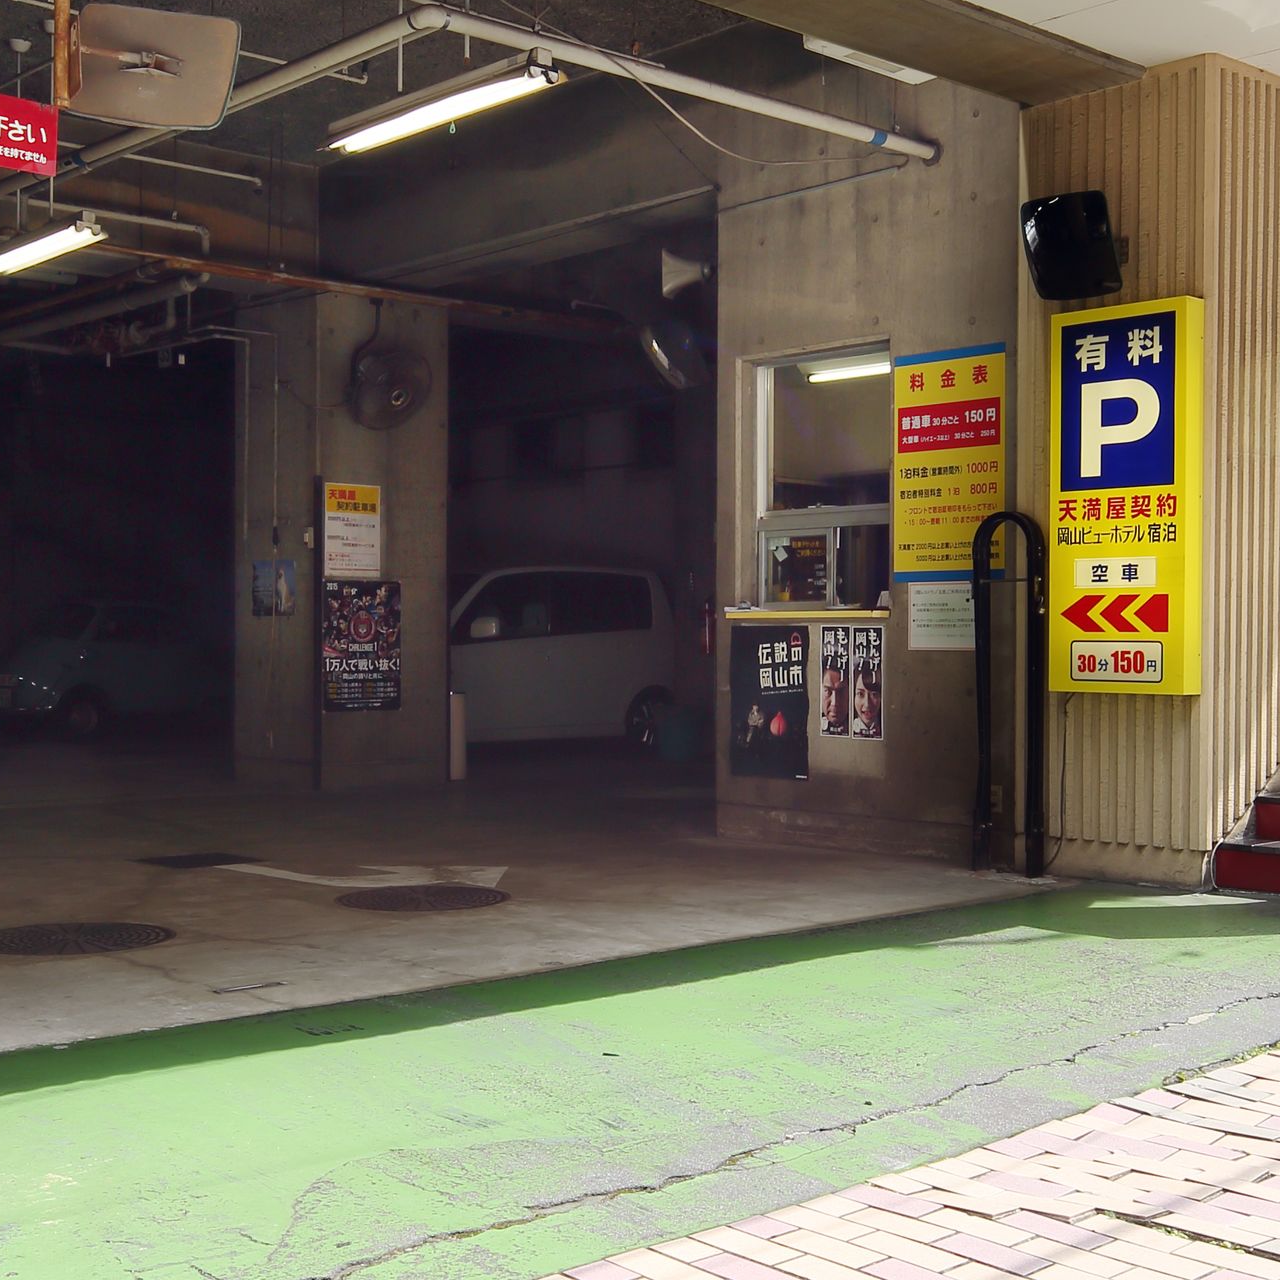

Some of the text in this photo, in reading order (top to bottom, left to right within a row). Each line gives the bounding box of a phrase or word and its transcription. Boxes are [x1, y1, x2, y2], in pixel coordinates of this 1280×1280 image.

[1074, 324, 1163, 373] 有料
[909, 364, 988, 392] 料金表
[964, 408, 996, 423] 150円
[1080, 377, 1161, 478] P
[966, 460, 998, 474] 1000円
[970, 482, 997, 495] 800円
[1058, 493, 1178, 522] 天満屋契約
[1057, 522, 1177, 546] 岡山ビューホテル 宿泊
[1091, 562, 1140, 583] 空車
[758, 642, 802, 664] 伝説の
[837, 627, 849, 682] もんげー
[868, 628, 881, 684] もんげー
[759, 665, 803, 689] 岡山市
